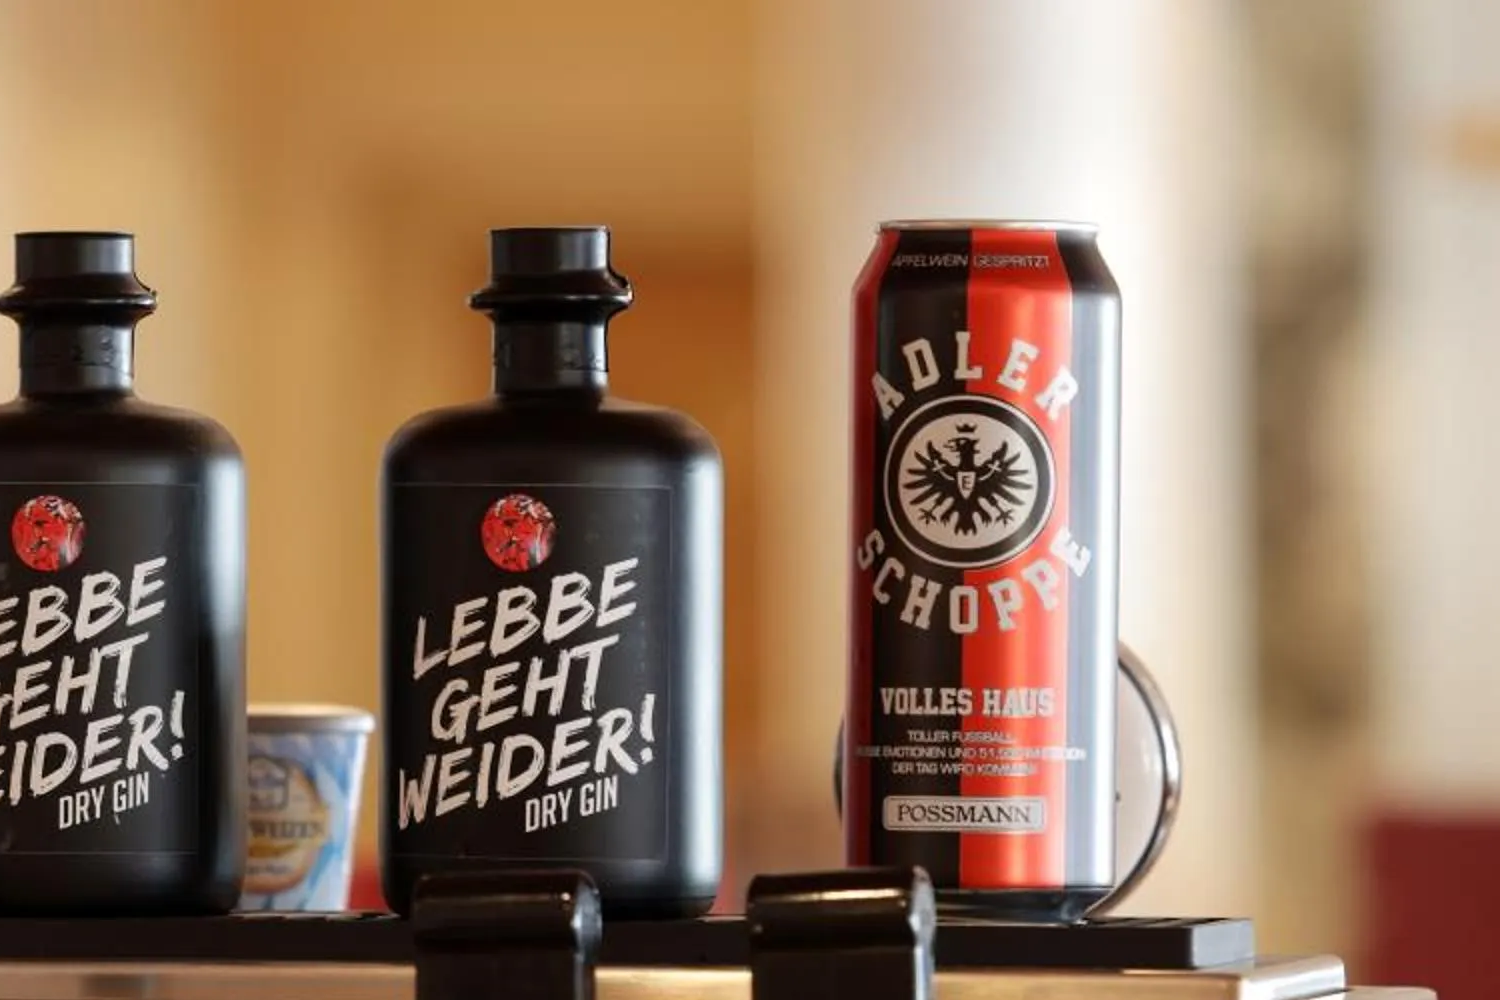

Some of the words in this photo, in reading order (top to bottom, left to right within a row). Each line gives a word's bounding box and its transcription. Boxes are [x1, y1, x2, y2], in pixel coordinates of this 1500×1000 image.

[871, 331, 1078, 421] ADLER
[857, 526, 1091, 634] SCHOPPE
[413, 557, 639, 680] LEBBE
[431, 634, 619, 744] GEHT
[880, 687, 973, 716] VOLLES
[982, 687, 1055, 718] HAUS
[399, 693, 655, 830] WEIDER!
[907, 730, 949, 743] TOLLER
[59, 785, 106, 829] DRY
[113, 772, 149, 813] GIN
[525, 787, 573, 832] DRY
[580, 776, 618, 817] GIN
[898, 803, 1031, 823] POSSMANN
